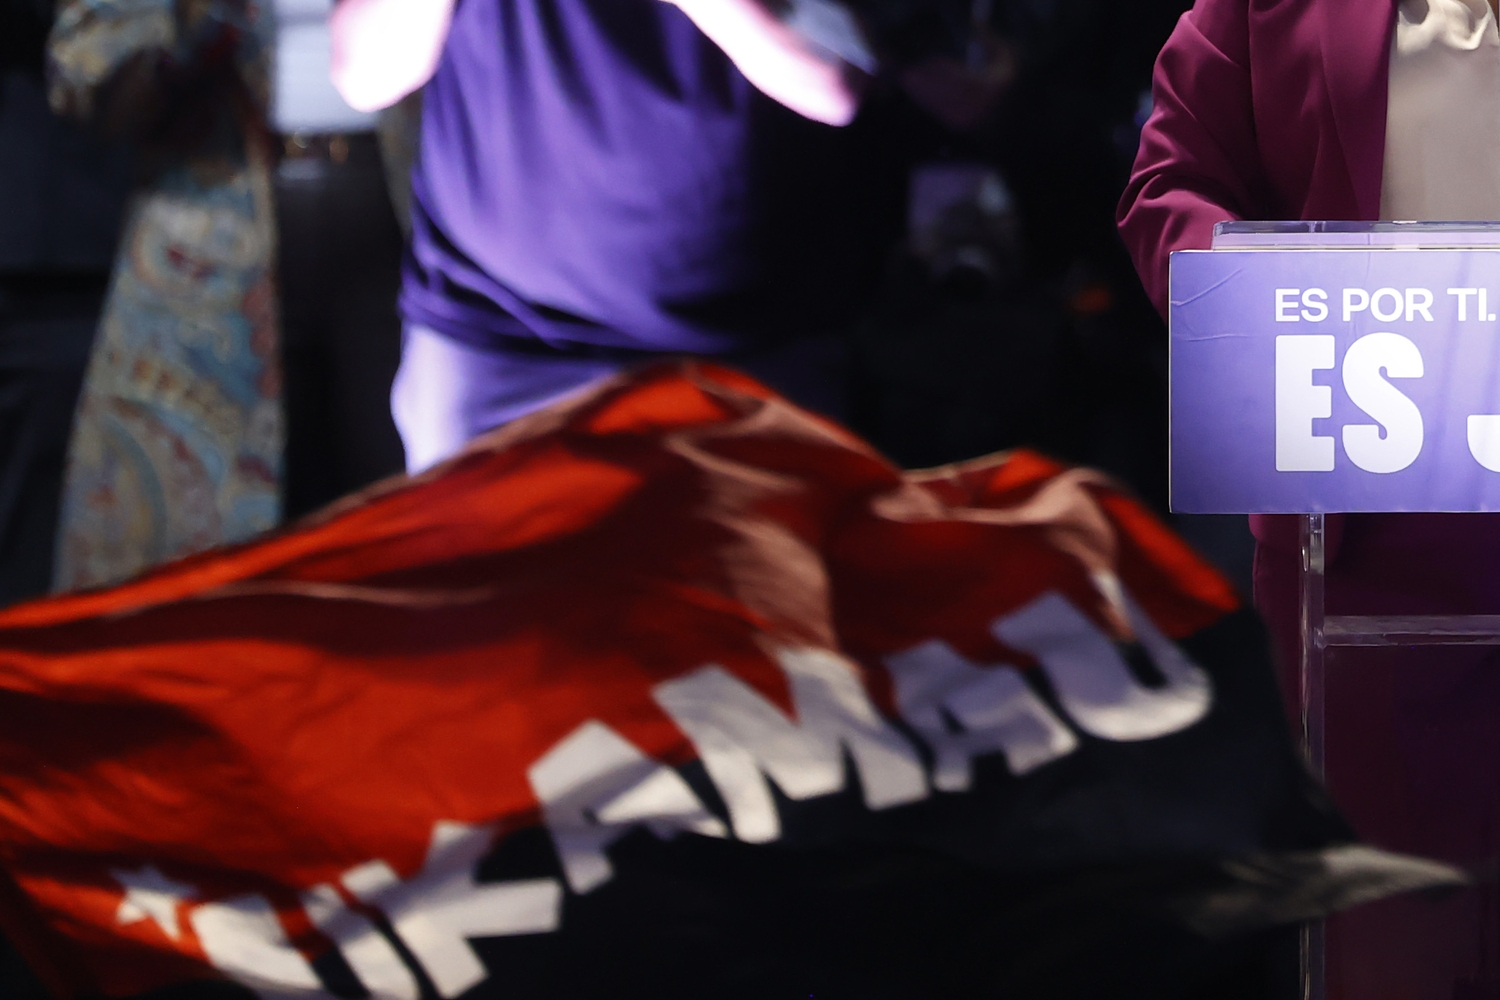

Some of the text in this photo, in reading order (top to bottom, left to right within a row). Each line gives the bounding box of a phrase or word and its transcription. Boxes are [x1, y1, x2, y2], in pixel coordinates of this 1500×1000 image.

[1275, 287, 1328, 321] ES
[1342, 287, 1434, 321] POR
[1446, 287, 1496, 321] TI.
[1275, 332, 1424, 473] ES
